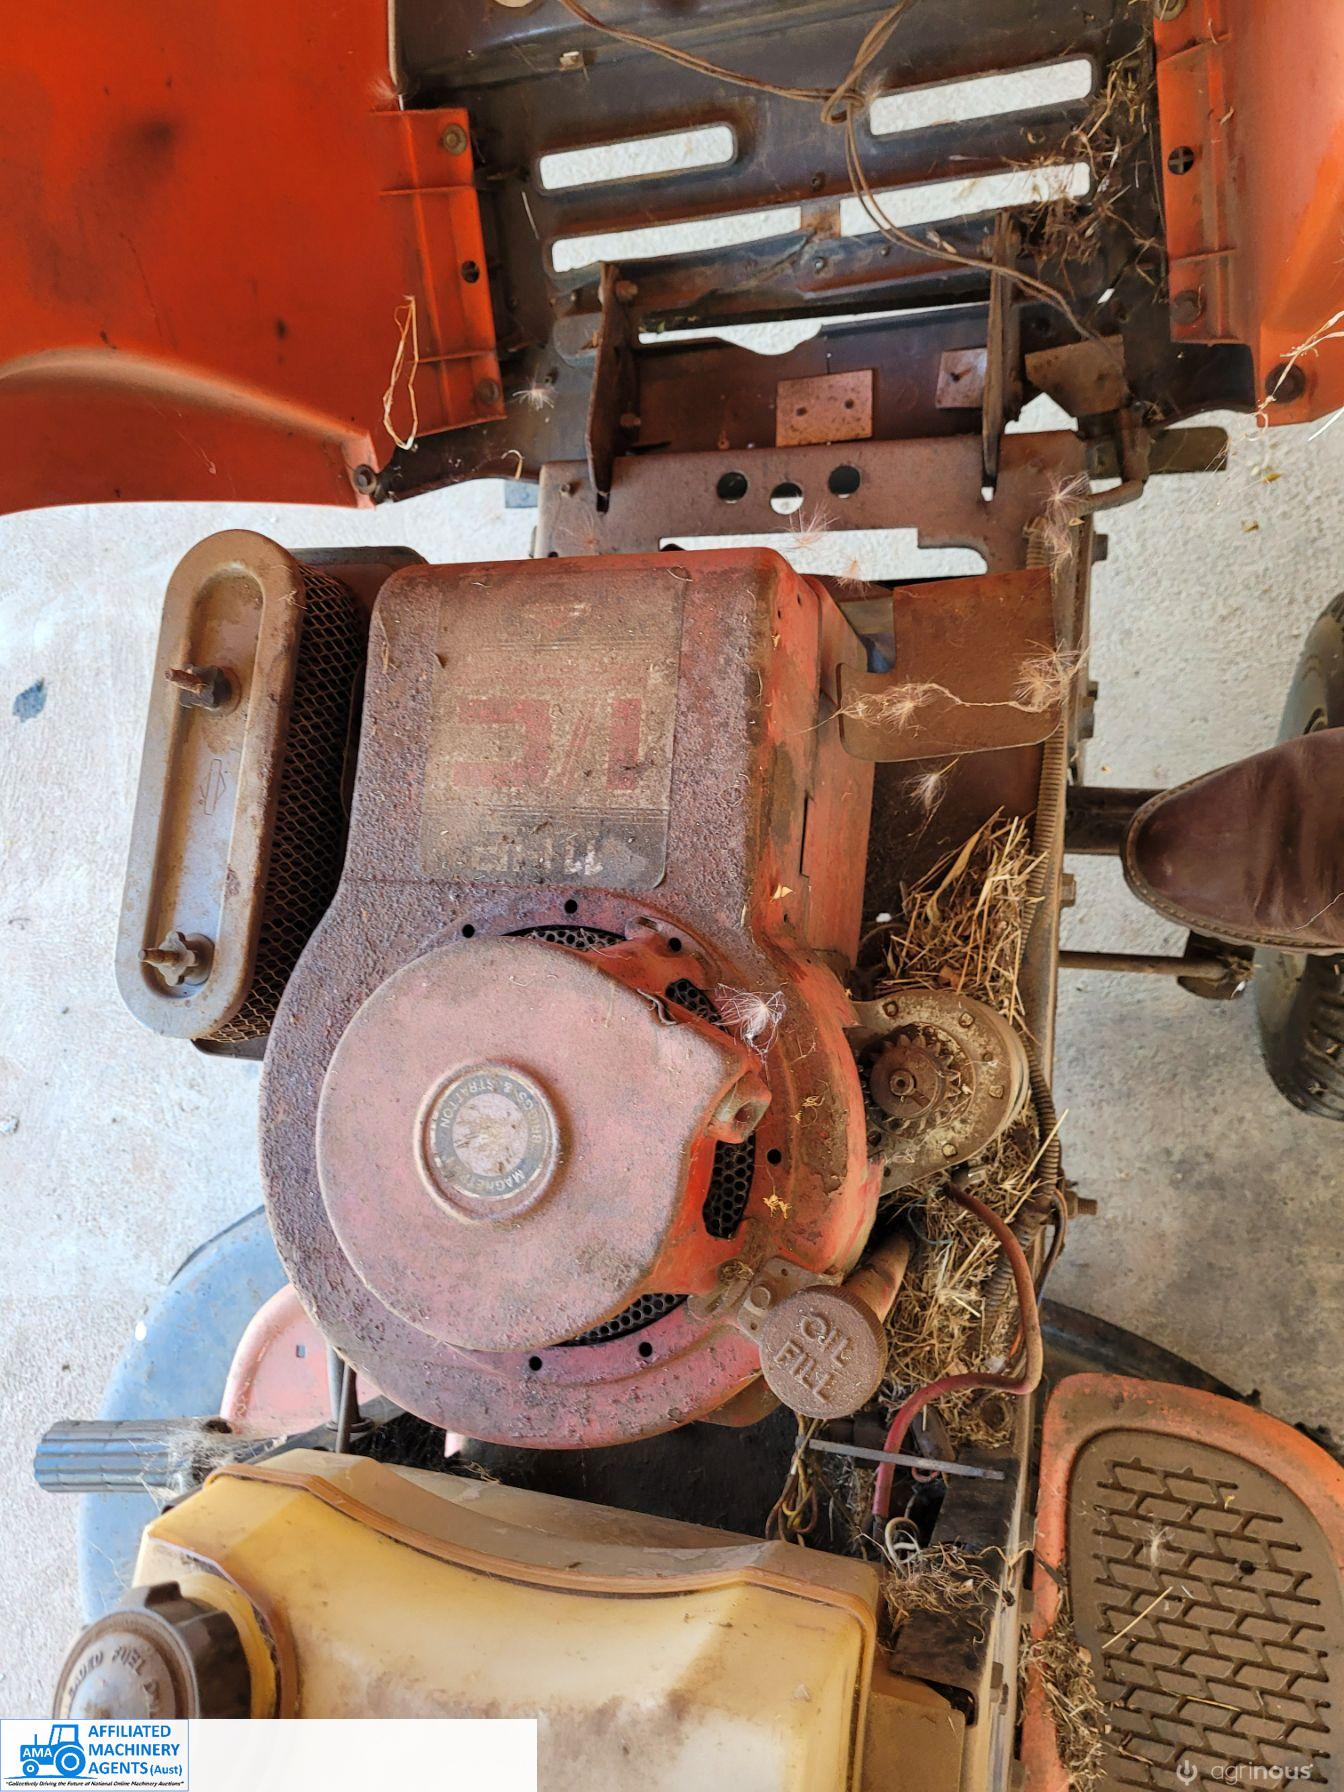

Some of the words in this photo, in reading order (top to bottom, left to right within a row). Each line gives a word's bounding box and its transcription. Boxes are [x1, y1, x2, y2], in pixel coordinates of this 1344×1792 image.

[439, 1079, 495, 1129] STRATTON
[799, 1313, 850, 1370] OIL
[773, 1340, 834, 1403] FILL
